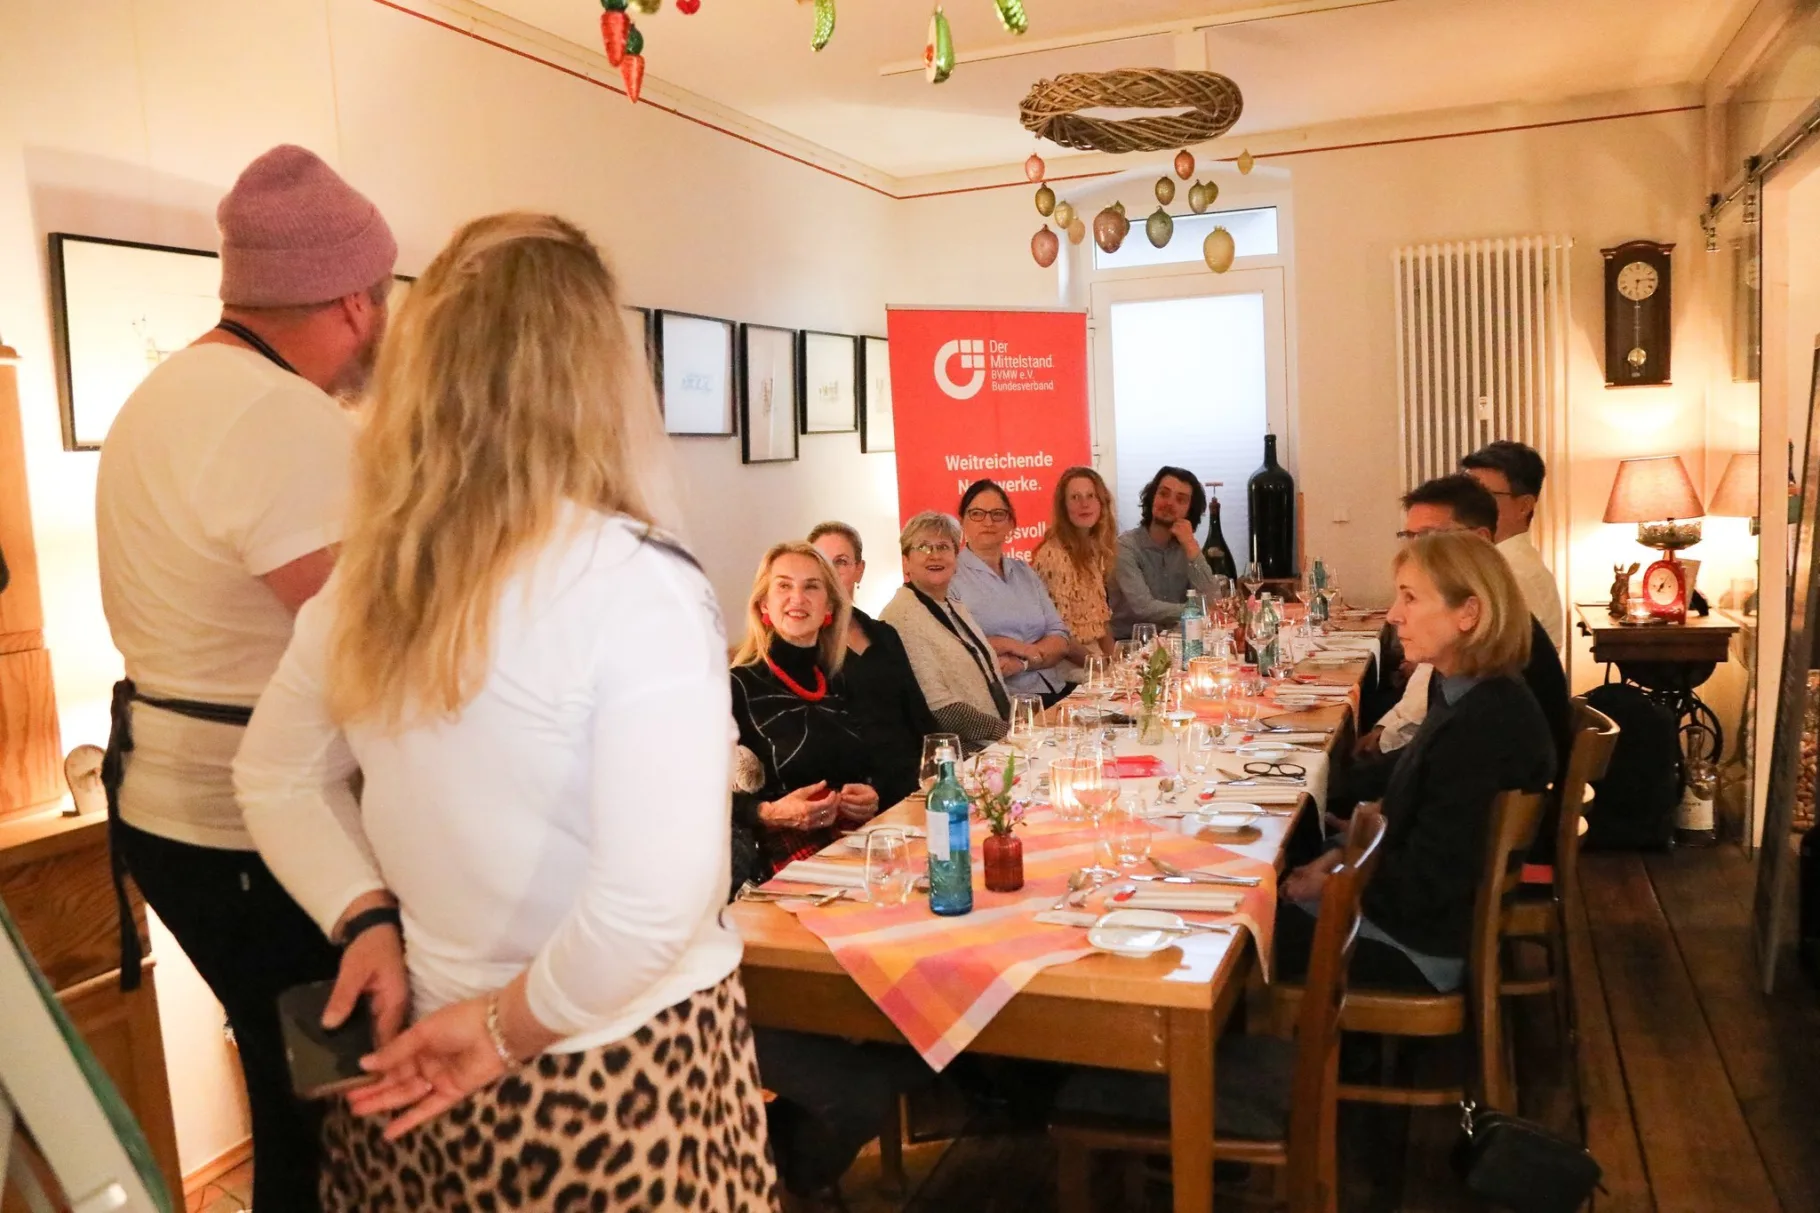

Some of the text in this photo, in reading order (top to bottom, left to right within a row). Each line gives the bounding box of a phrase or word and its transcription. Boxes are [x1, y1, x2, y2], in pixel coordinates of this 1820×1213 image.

[989, 339, 1008, 353] Der
[991, 369, 1034, 379] BVMW e.V.
[992, 380, 1054, 391] Bundesverband
[945, 451, 1053, 471] Weitreichende
